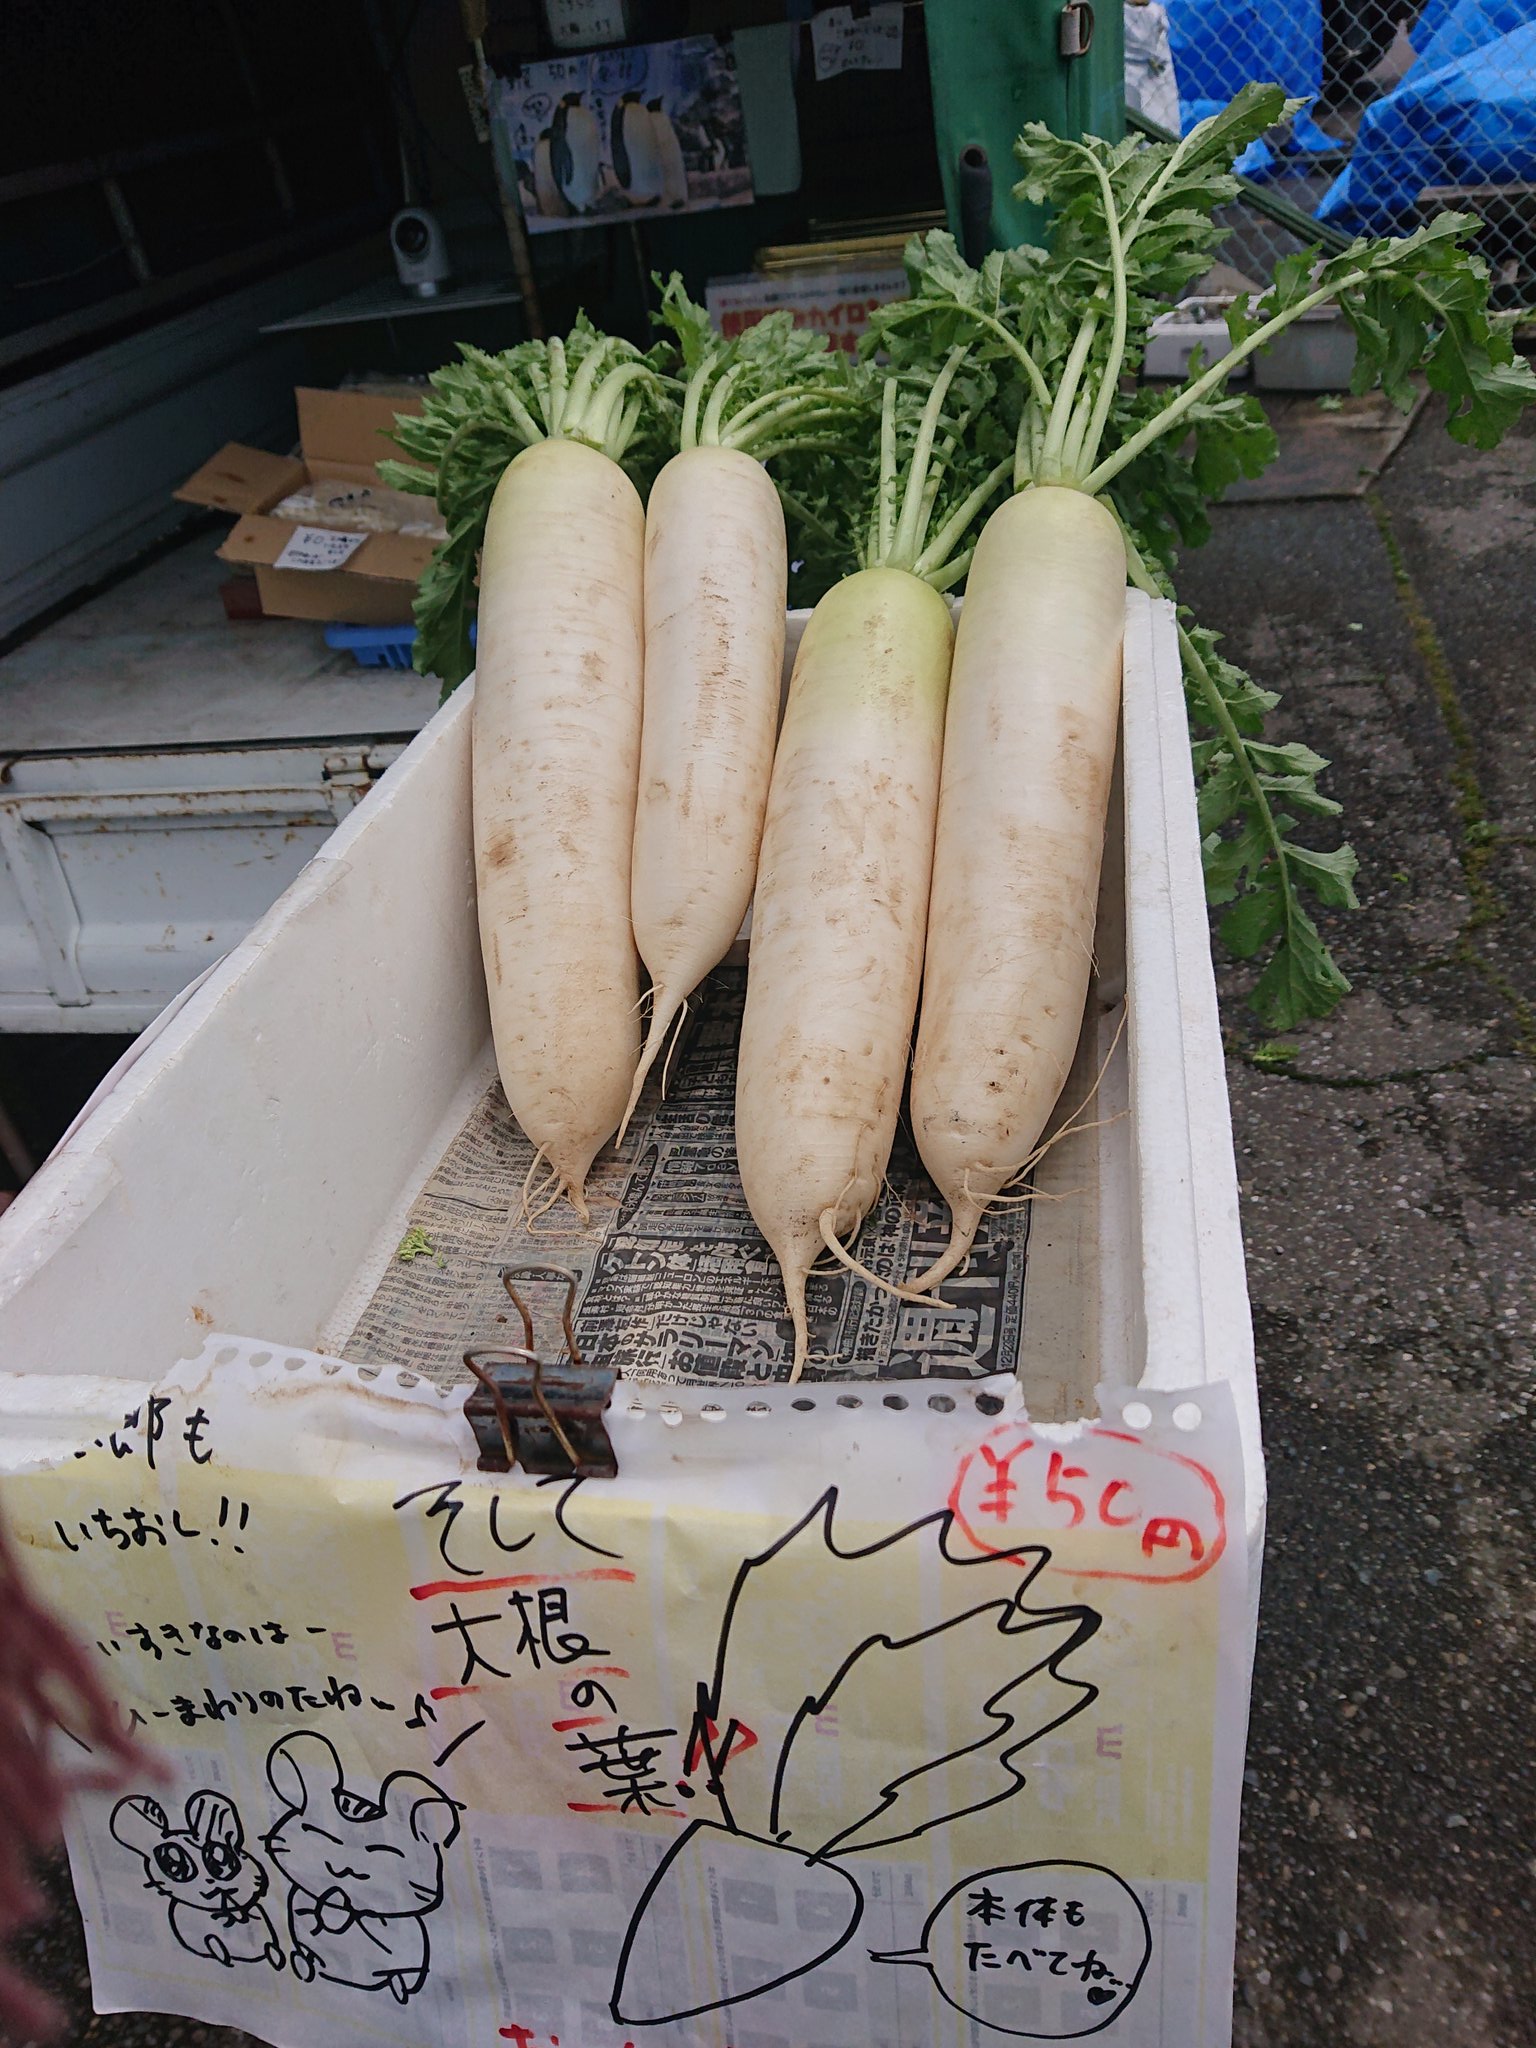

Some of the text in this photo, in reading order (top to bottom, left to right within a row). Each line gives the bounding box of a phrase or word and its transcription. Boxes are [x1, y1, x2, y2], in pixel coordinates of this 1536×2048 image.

[54, 1495, 250, 1555] いちおし!!
[392, 1473, 624, 1577] そして
[430, 1586, 612, 1686] 大根
[966, 1886, 1087, 1929] 本体も
